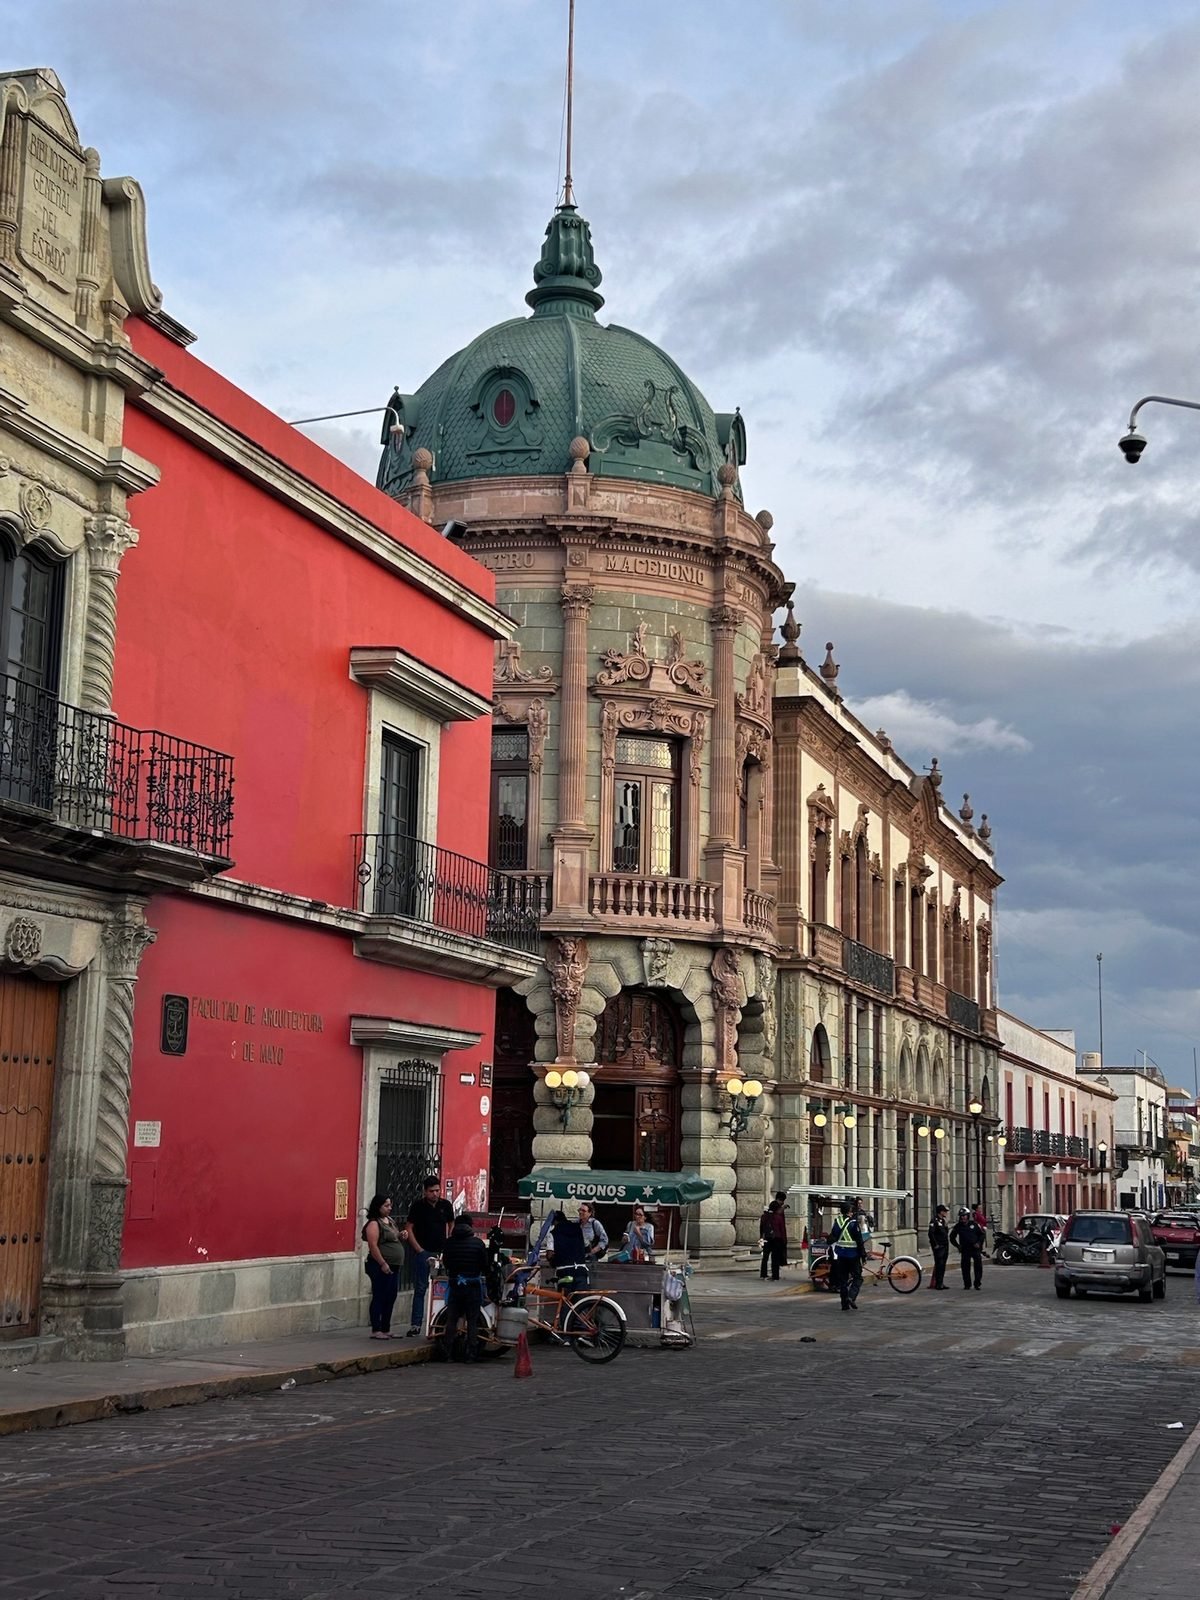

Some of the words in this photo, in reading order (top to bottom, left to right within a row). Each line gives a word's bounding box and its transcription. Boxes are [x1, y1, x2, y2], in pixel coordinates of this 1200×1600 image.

[29, 133, 78, 190] BIBLIOTECA
[33, 169, 72, 216] GENERAL
[42, 206, 59, 239] DEL
[31, 232, 67, 275] ESTADO
[471, 552, 535, 570] ATRO
[605, 554, 704, 586] MACEDONIO
[191, 997, 240, 1022] FACULTAD
[245, 1005, 256, 1025] DE
[262, 1007, 323, 1033] ARQUITECTURA
[242, 1041, 255, 1063] DE
[259, 1044, 285, 1066] MAYO
[536, 1181, 553, 1193] EL
[567, 1183, 627, 1197] CRONOS
